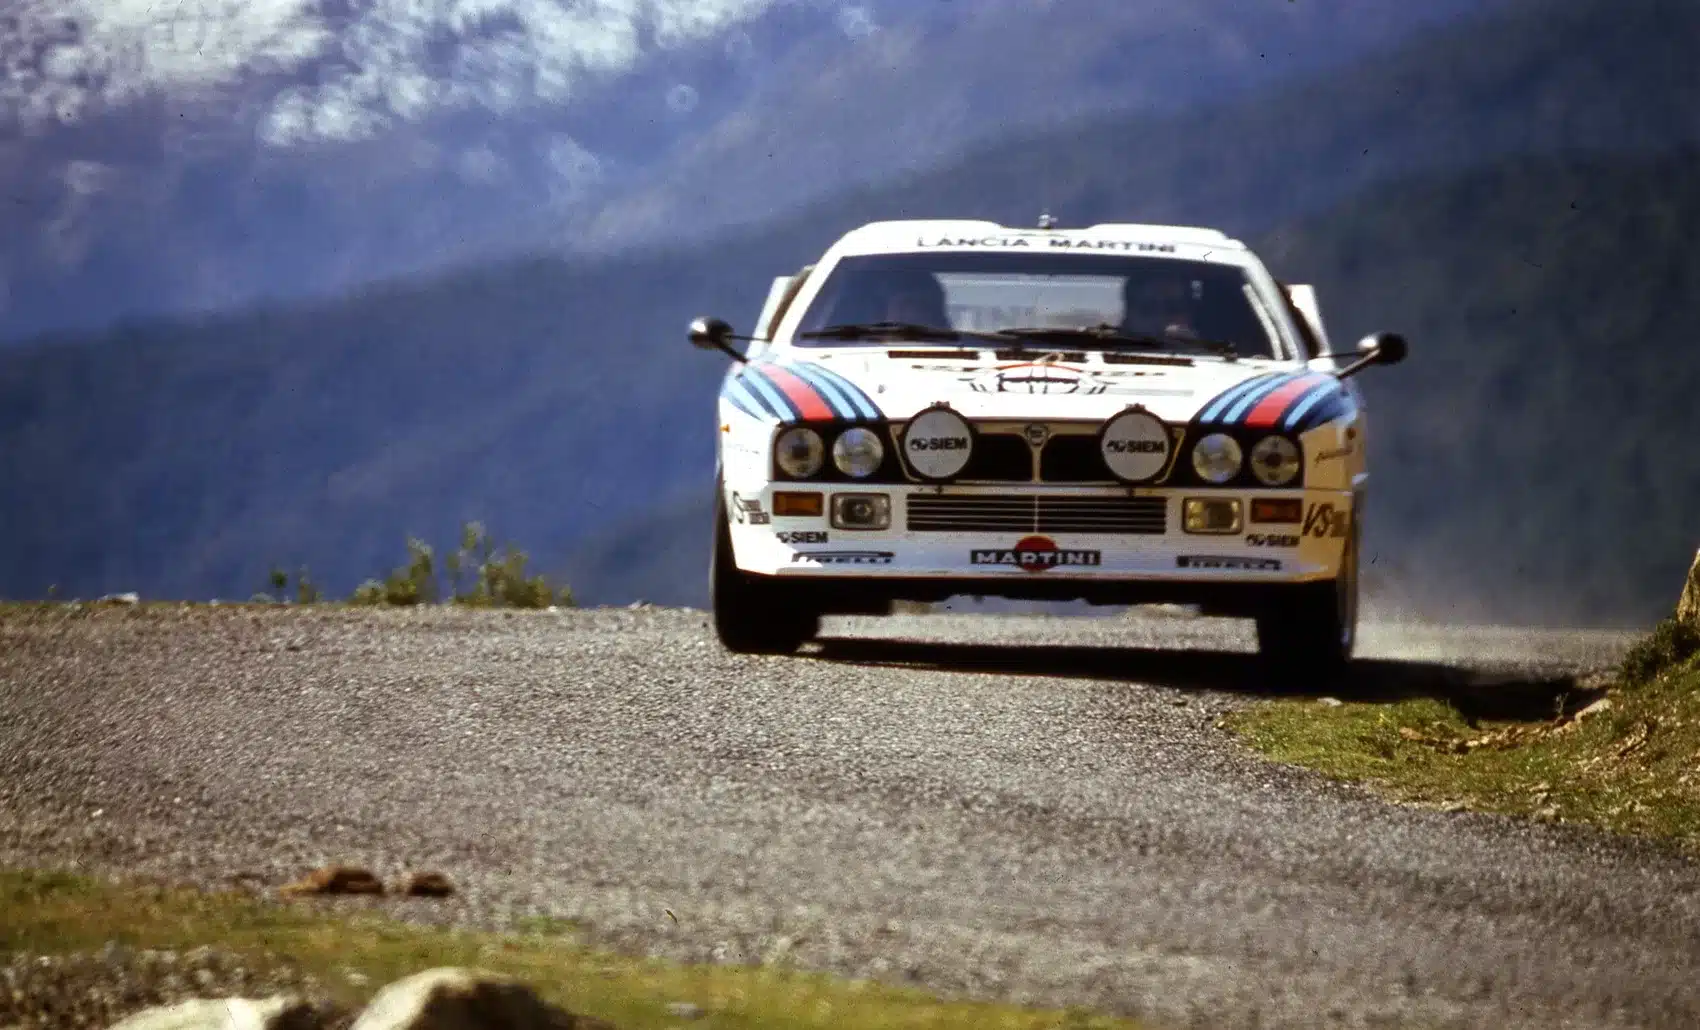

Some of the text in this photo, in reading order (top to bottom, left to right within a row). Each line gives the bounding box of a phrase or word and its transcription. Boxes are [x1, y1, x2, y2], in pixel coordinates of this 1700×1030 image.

[917, 238, 1175, 252] LANCIA MARTINI
[929, 437, 968, 450] SIEM
[1127, 440, 1166, 453] SIEM
[791, 531, 828, 544] SIEM
[976, 551, 1098, 565] MARTINI
